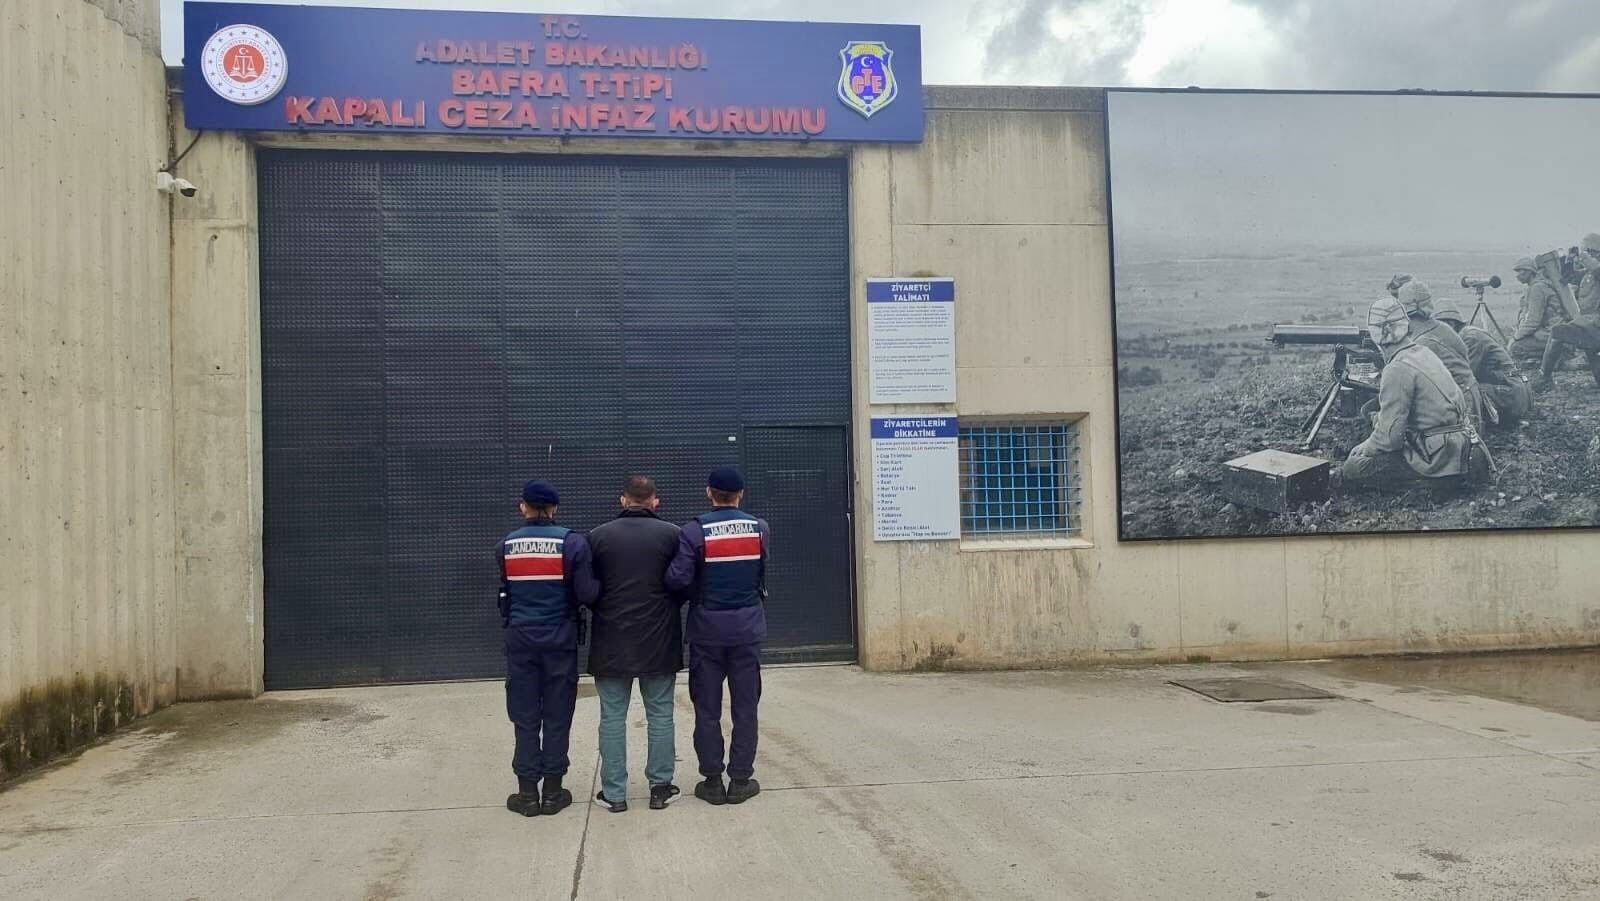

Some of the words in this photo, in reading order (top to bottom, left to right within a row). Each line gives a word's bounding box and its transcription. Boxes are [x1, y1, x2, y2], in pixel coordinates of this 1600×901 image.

[540, 17, 588, 39] T.C.
[415, 40, 536, 65] ADALET
[452, 70, 570, 98] BAFRA
[285, 96, 426, 128] KAPALI
[439, 101, 541, 130] CEZA
[668, 107, 826, 135] KURUMU
[891, 282, 931, 292] ZİYARETÇİ
[893, 293, 930, 302] TALİMATI
[883, 418, 947, 428] ZİYARETÇİLERİN
[894, 429, 937, 438] DİKKATİNE
[708, 523, 755, 537] JANDARMA
[509, 540, 557, 554] JANDARMA
